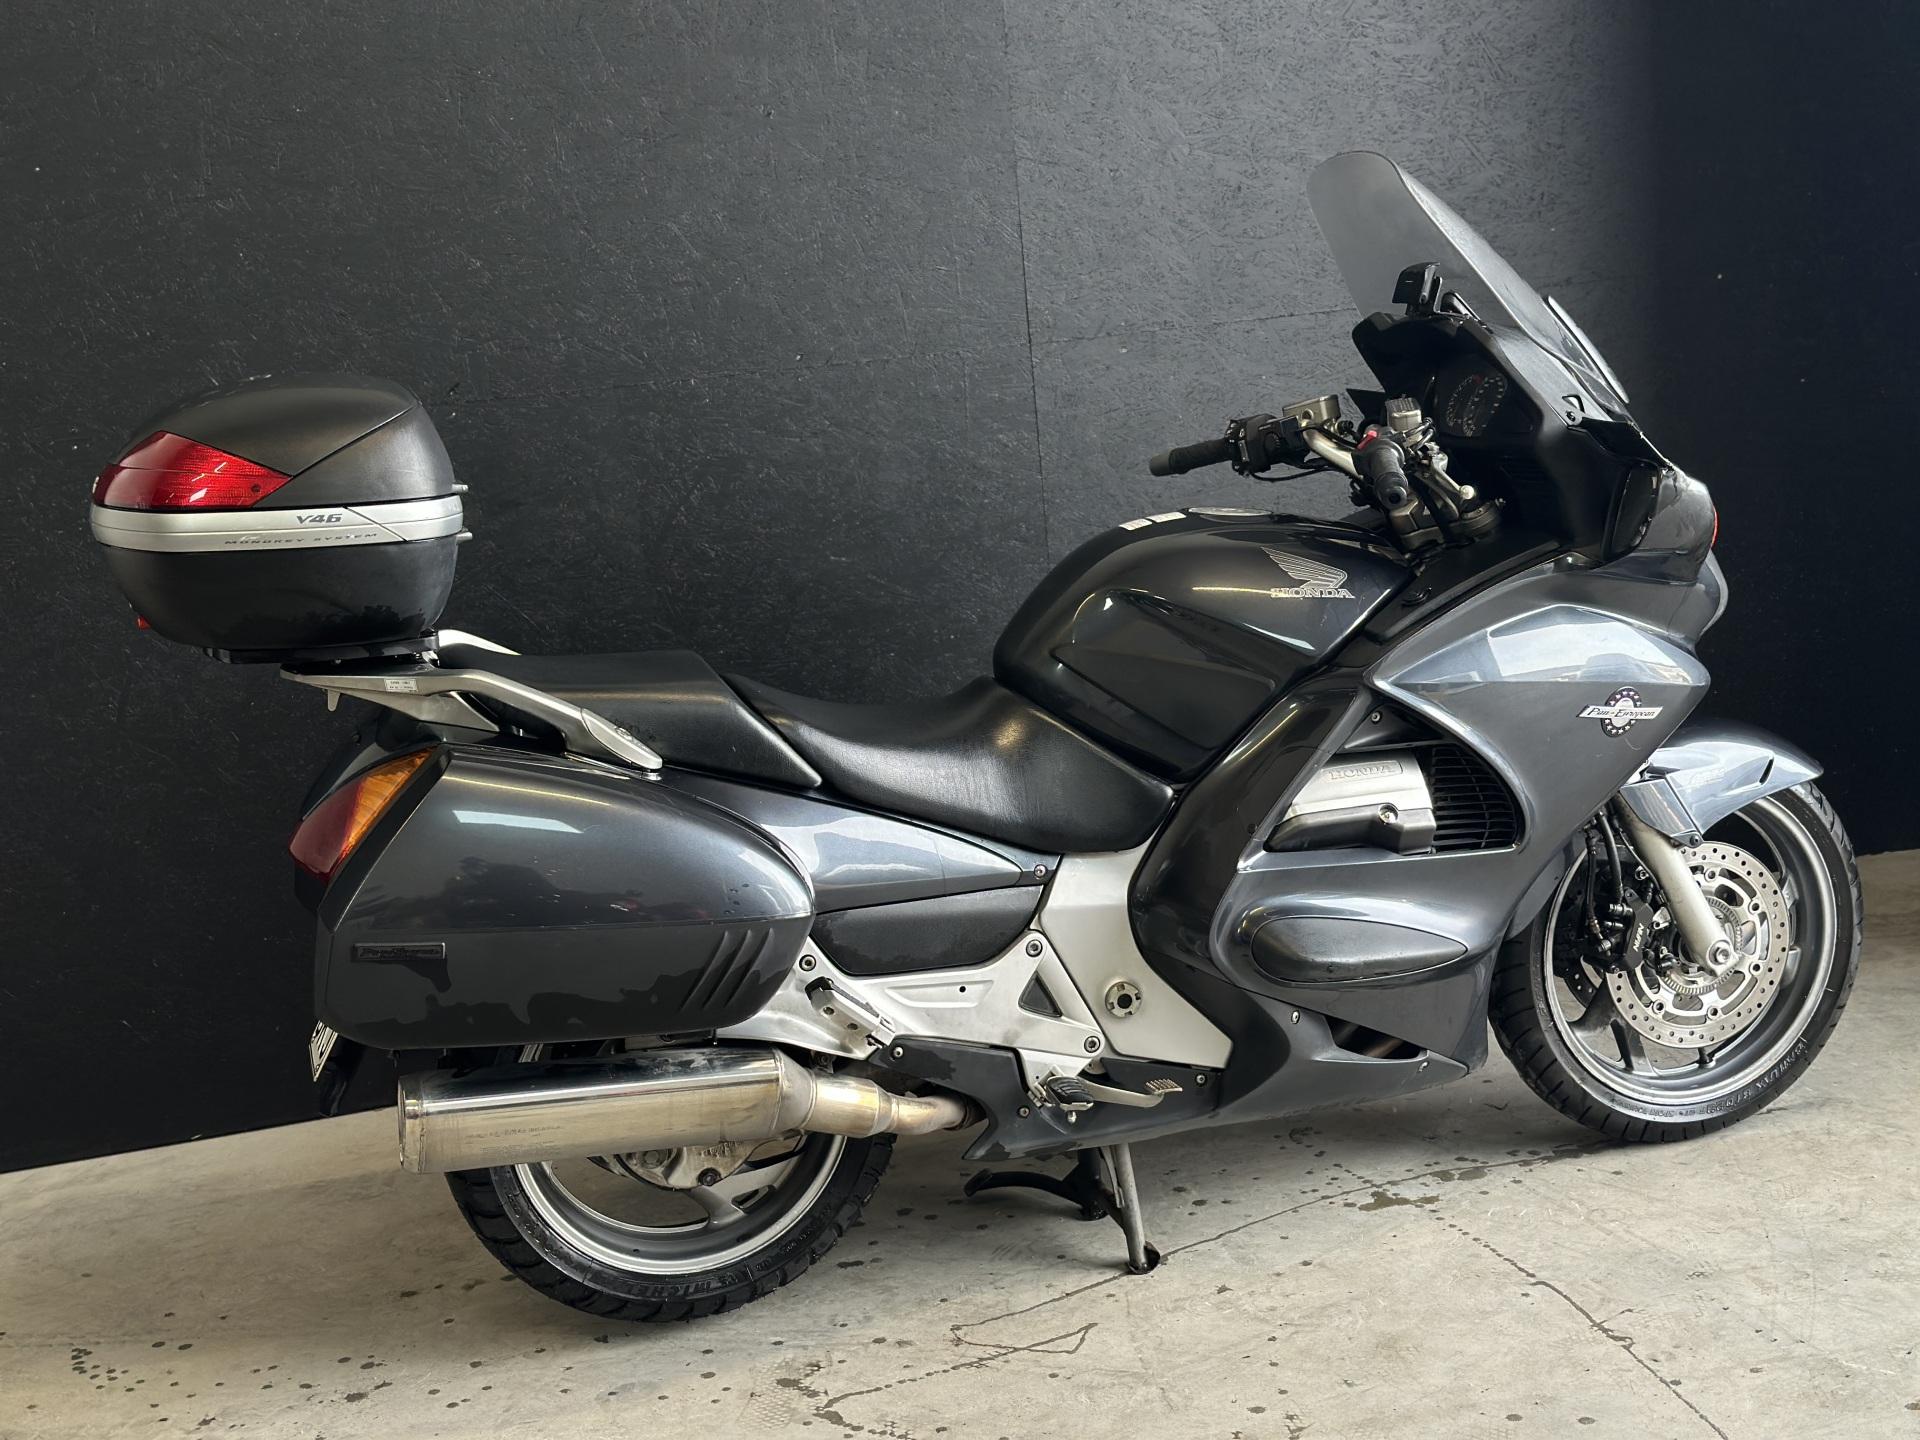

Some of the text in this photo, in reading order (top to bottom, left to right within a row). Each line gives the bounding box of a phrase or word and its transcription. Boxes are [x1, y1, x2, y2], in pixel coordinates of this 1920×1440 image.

[296, 513, 342, 524] V46
[1270, 588, 1356, 599] HONDA
[1329, 763, 1394, 780] HONDA
